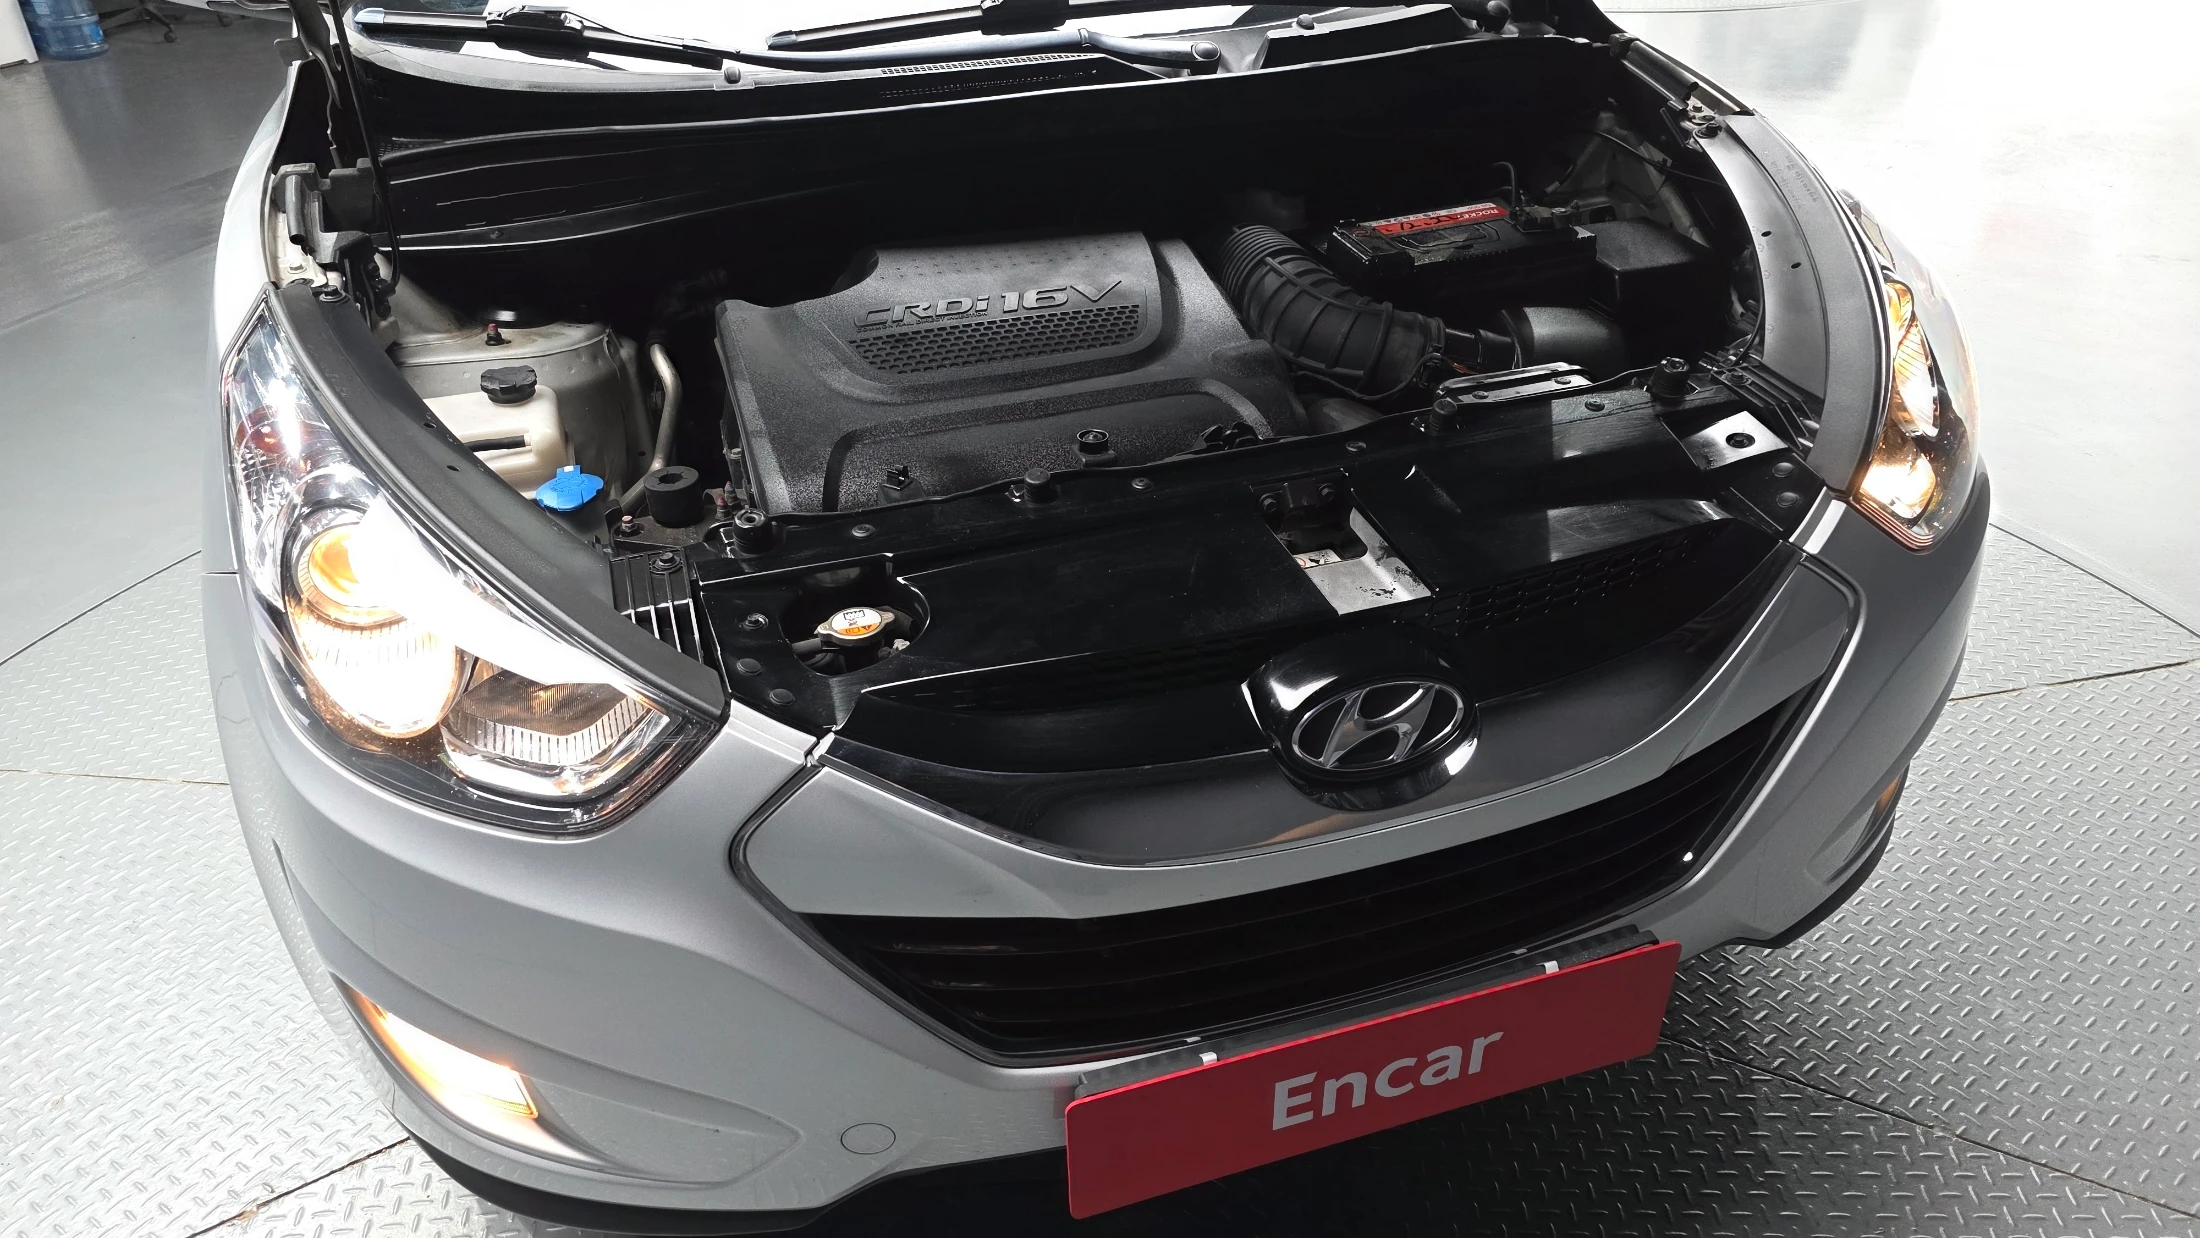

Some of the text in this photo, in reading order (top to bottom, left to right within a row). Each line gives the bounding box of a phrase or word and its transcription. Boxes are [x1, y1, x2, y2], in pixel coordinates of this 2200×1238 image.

[854, 280, 1122, 328] CRDi 16V
[856, 324, 894, 334] COMMON
[915, 316, 946, 325] DIRECT
[946, 311, 988, 321] INJECTION
[1272, 1031, 1504, 1131] Encar
